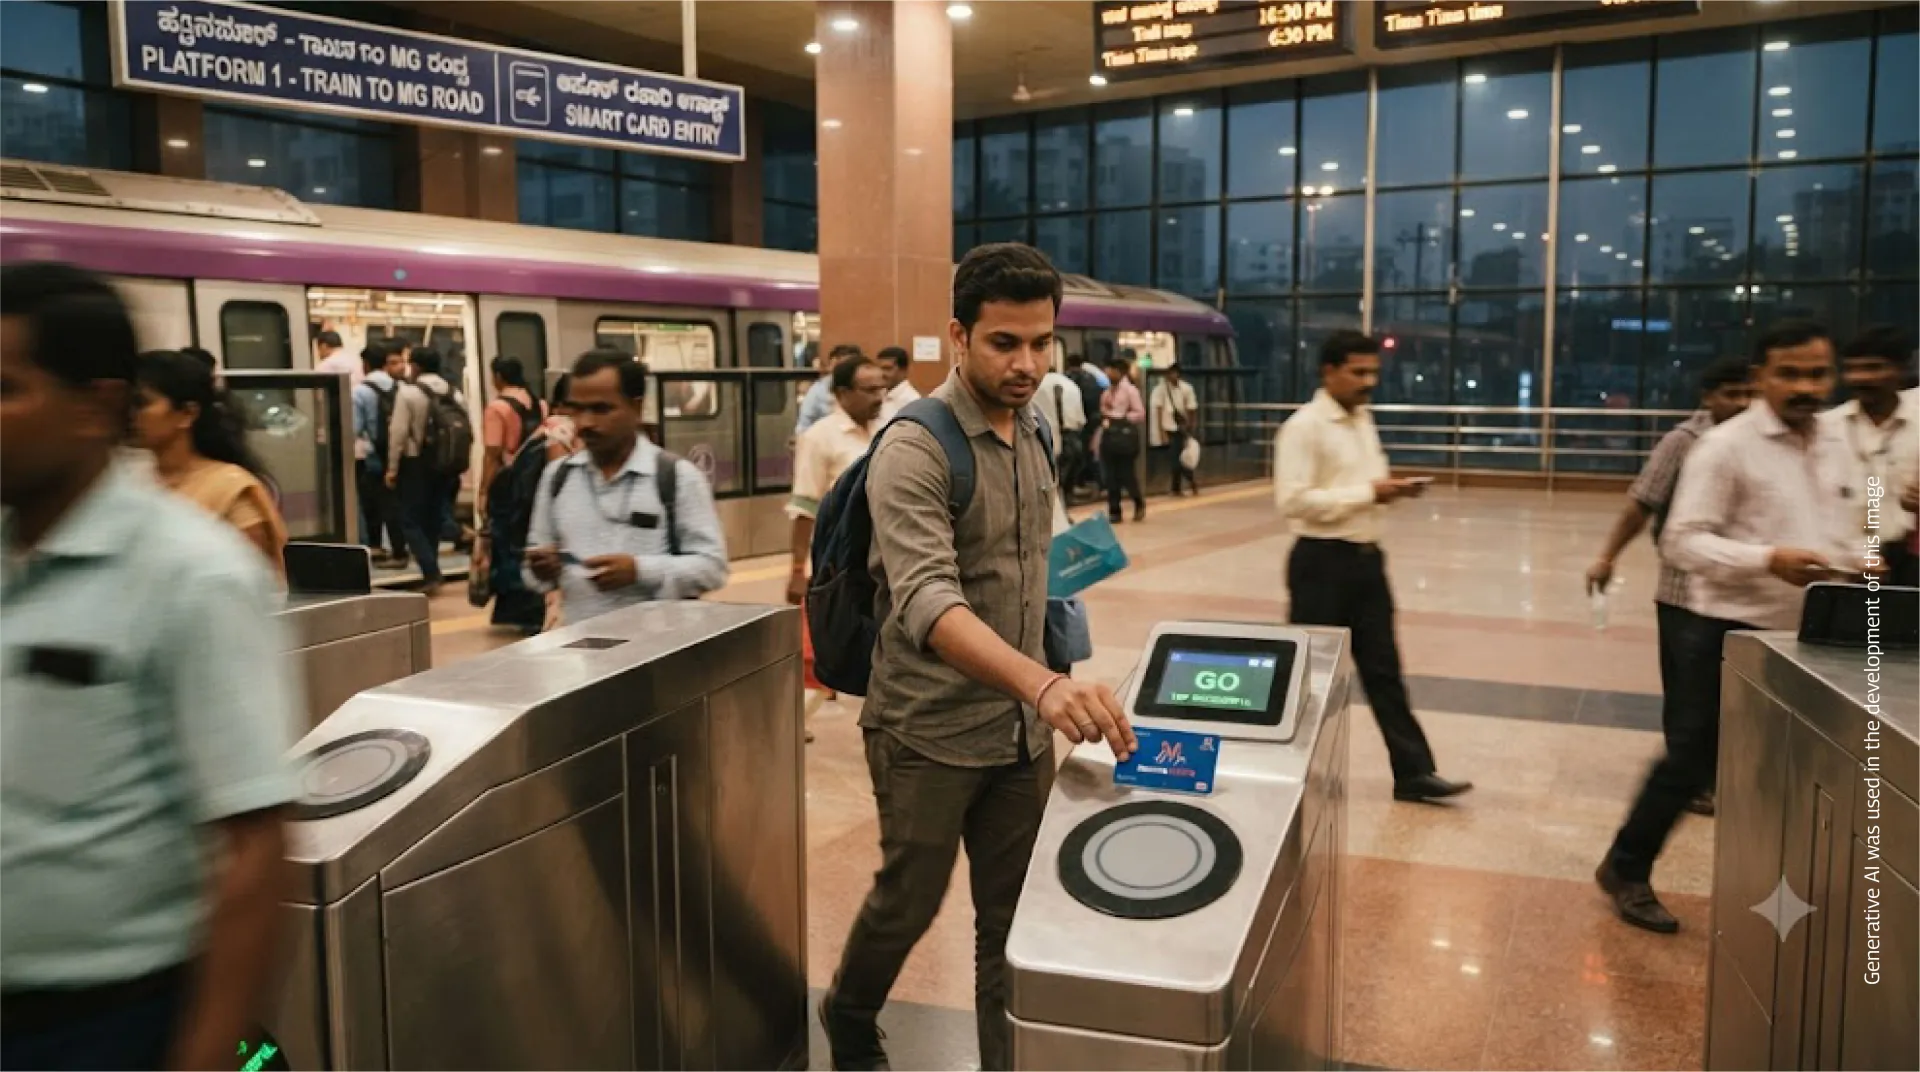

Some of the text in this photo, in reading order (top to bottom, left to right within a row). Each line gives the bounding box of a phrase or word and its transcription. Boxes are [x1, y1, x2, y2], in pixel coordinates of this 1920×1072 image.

[1305, 22, 1333, 41] PM
[141, 45, 266, 87] PLATFORM
[271, 62, 282, 88] 1
[300, 67, 362, 99] TRAIN
[366, 76, 393, 103] TO
[397, 81, 428, 108] MG
[432, 85, 484, 115] ROAD
[565, 103, 723, 146] SMART CARD ENTRY
[1194, 670, 1240, 691] GO
